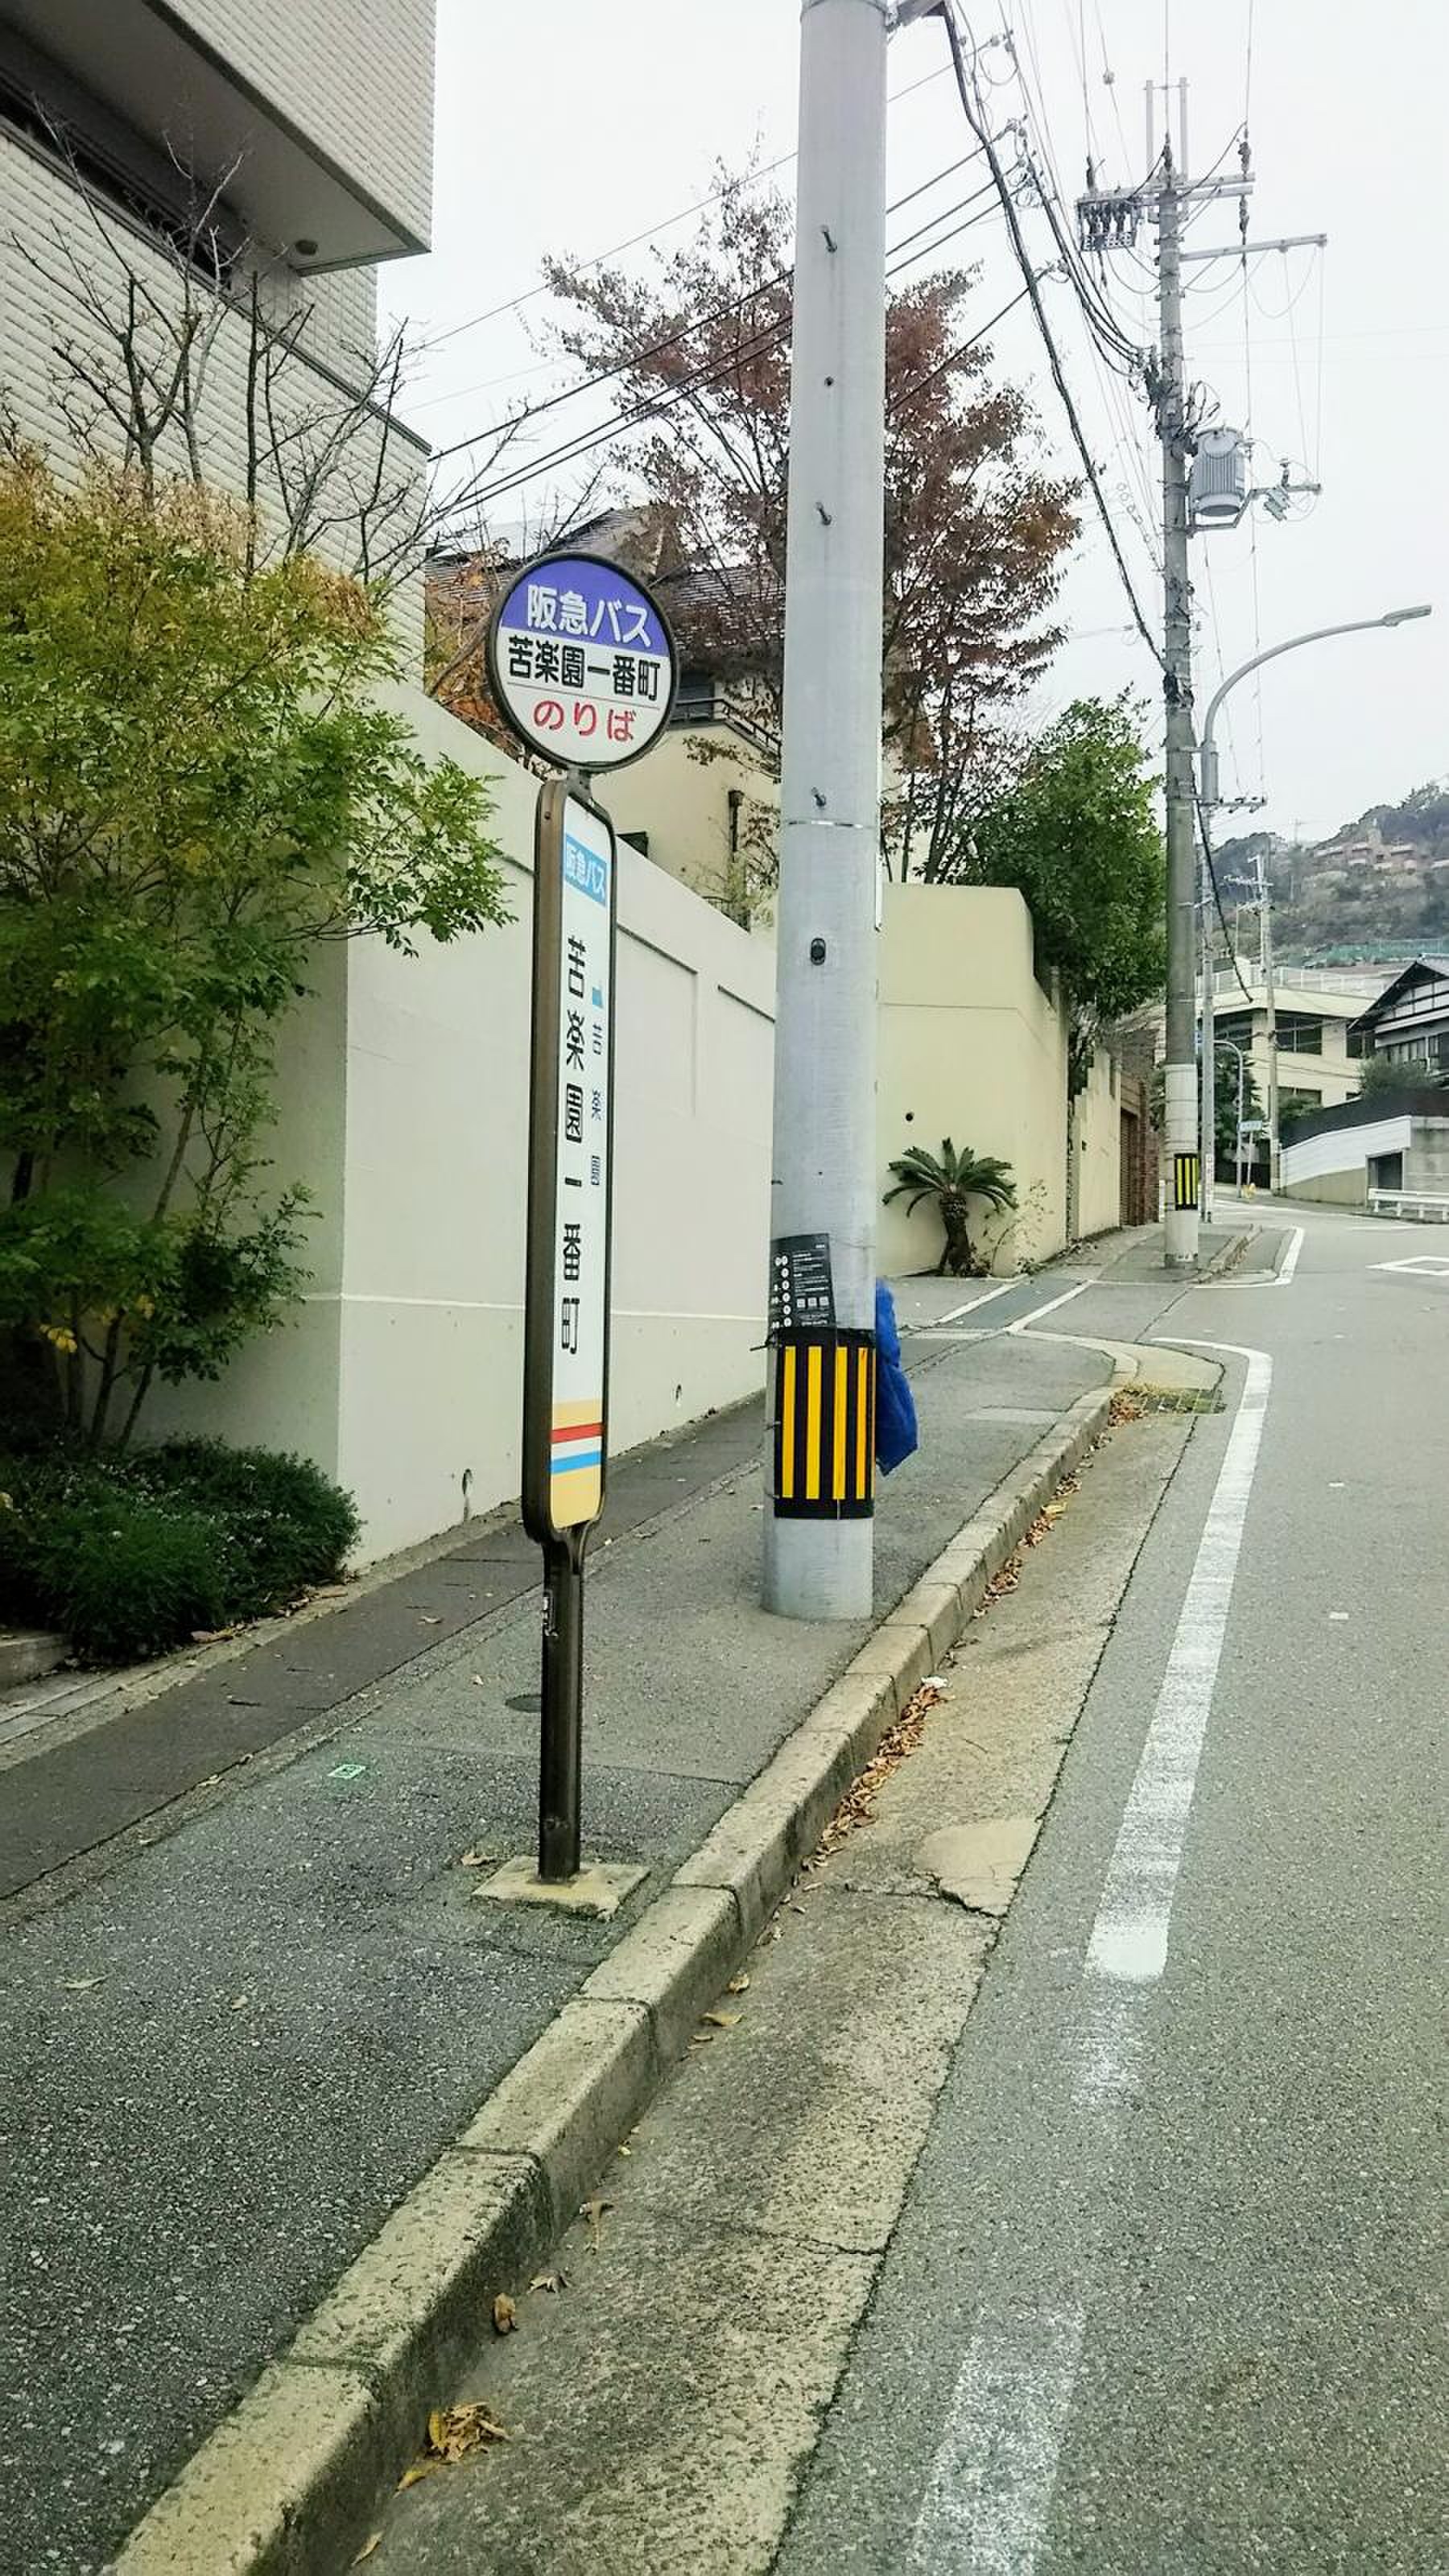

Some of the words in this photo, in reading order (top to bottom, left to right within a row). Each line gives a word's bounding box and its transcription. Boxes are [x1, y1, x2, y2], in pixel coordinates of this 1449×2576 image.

[527, 584, 651, 647] 阪急バス
[508, 635, 661, 701] 苦楽園一番町
[533, 700, 638, 742] のりば
[561, 933, 587, 1354] 苦楽園一番町
